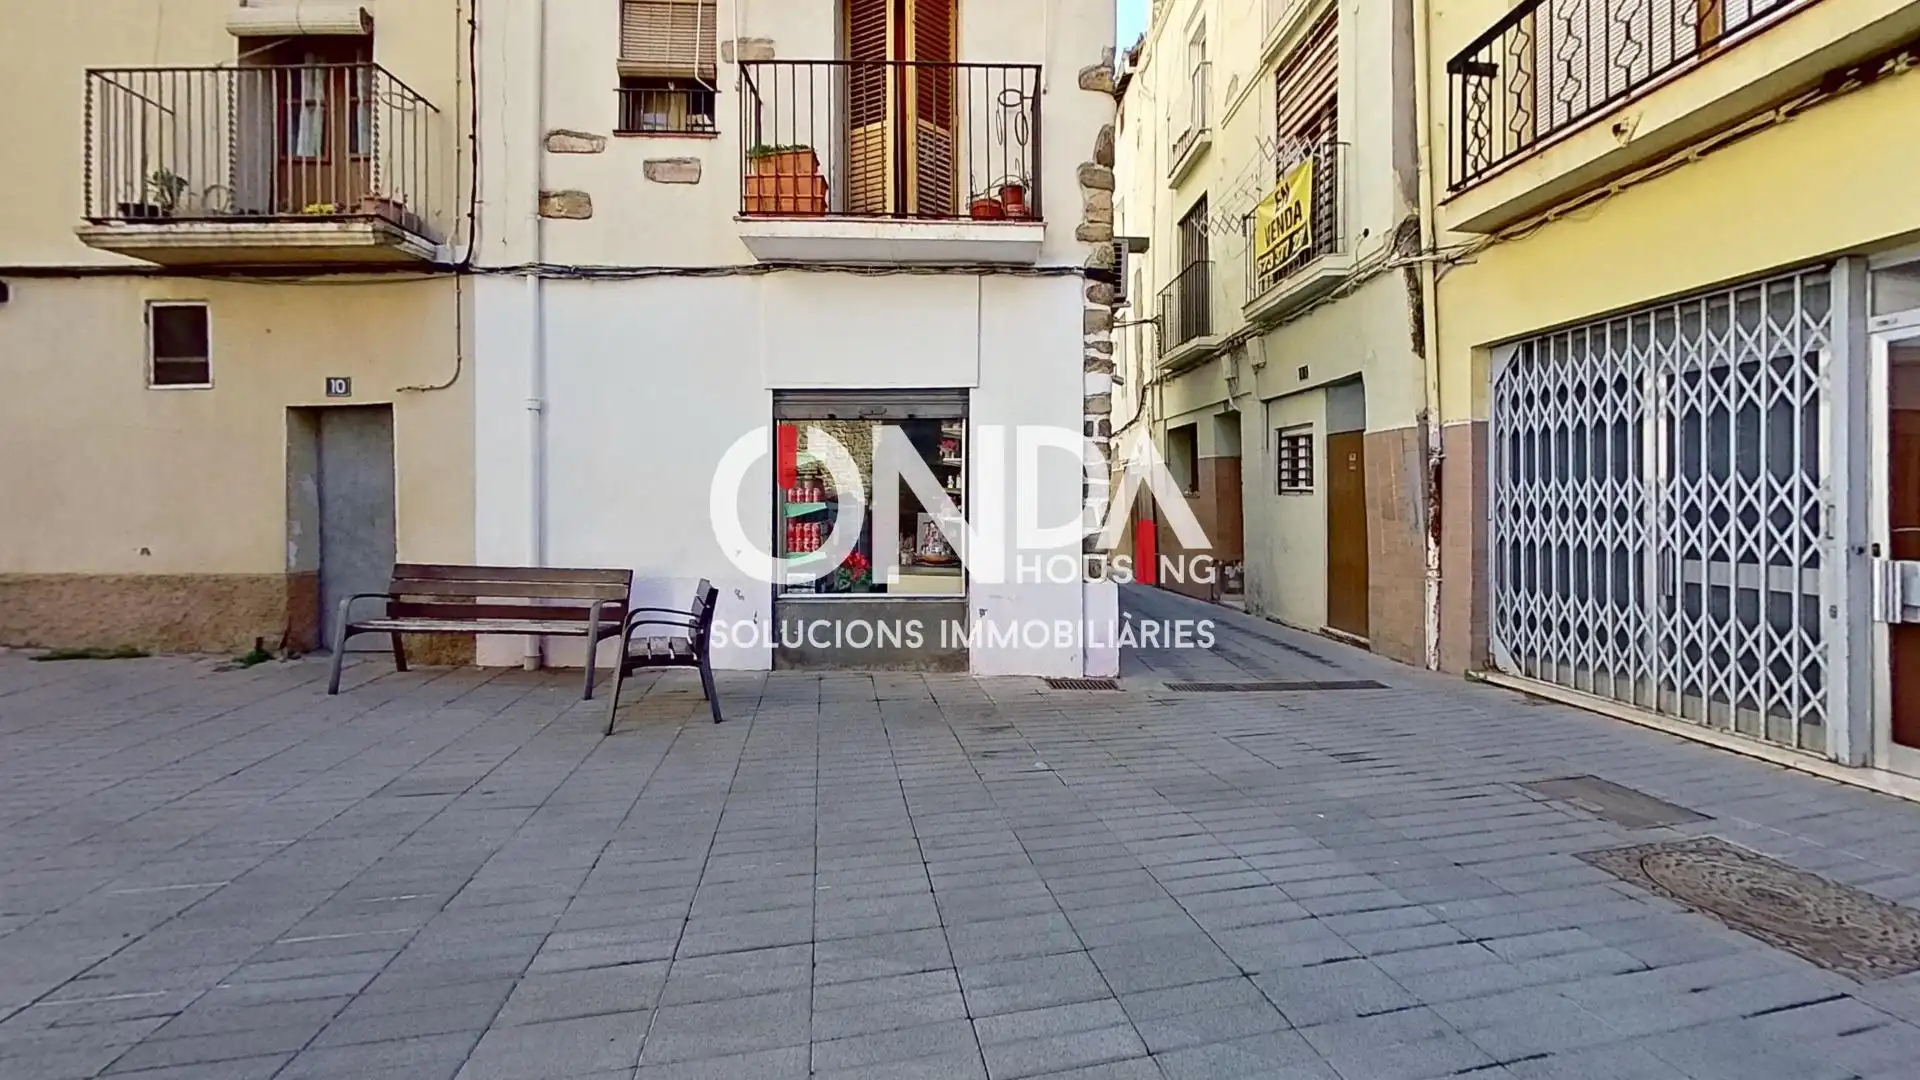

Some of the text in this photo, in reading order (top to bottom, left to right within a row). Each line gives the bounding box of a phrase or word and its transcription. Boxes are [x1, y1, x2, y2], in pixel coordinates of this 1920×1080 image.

[1274, 181, 1290, 212] EN
[1264, 199, 1303, 249] VENDA
[330, 379, 346, 393] 10
